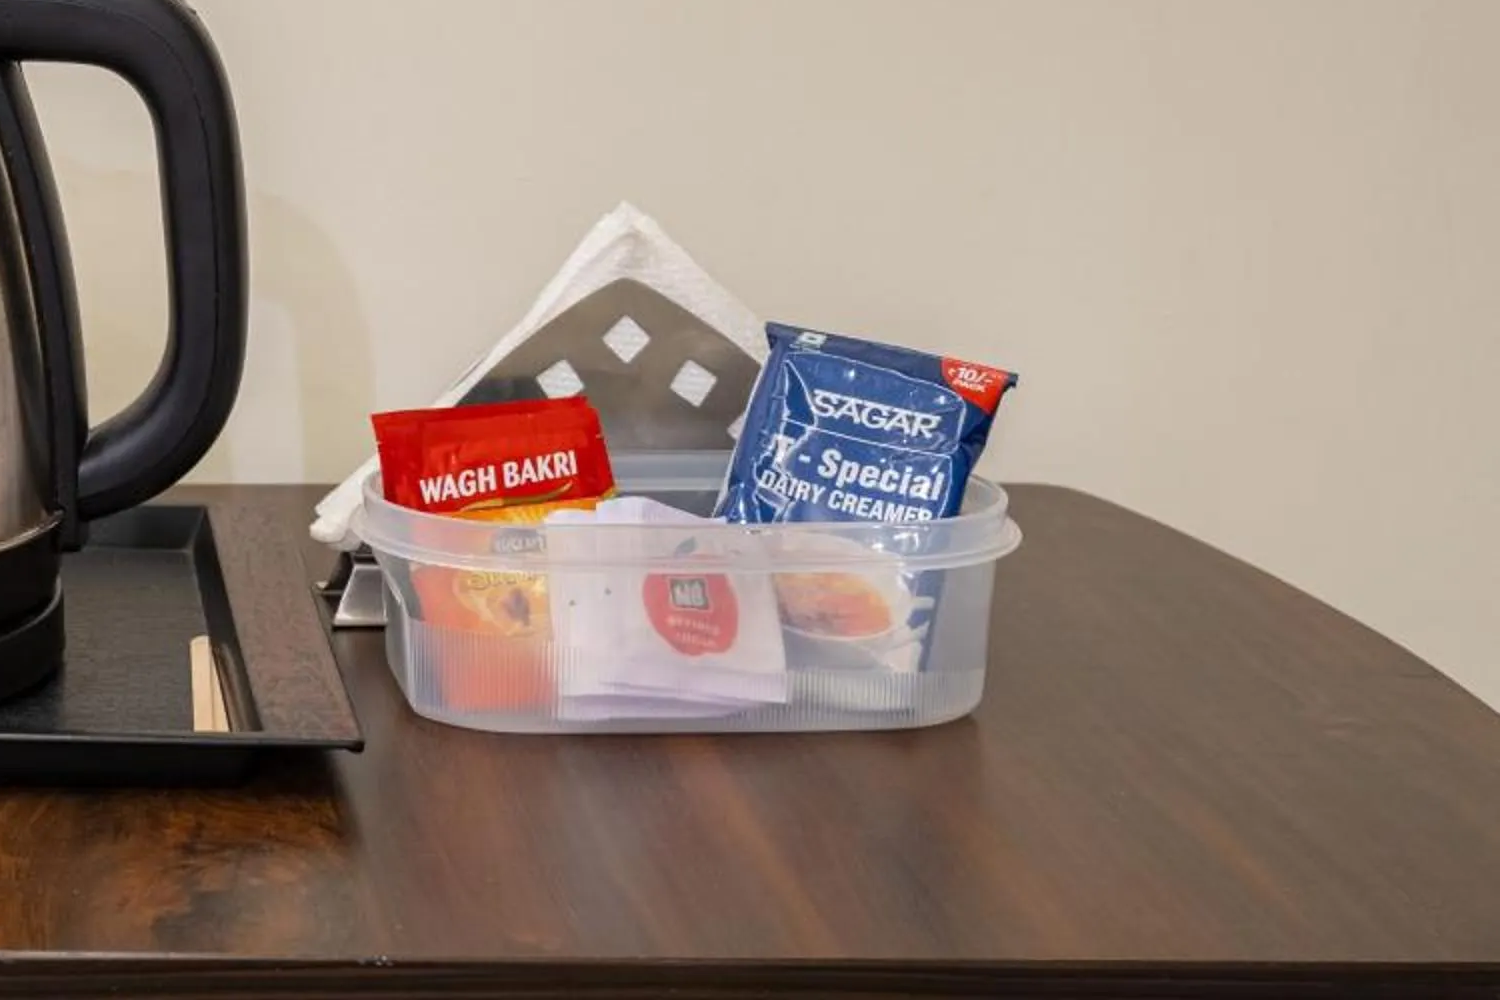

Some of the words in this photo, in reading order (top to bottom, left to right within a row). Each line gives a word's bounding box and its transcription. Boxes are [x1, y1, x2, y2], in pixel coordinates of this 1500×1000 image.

[813, 389, 941, 438] SAGAR
[419, 465, 497, 504] WAGH
[503, 450, 578, 488] BAKRI
[761, 470, 825, 504] DAIRY
[828, 490, 933, 521] CREAMER
[818, 449, 945, 501] Special
